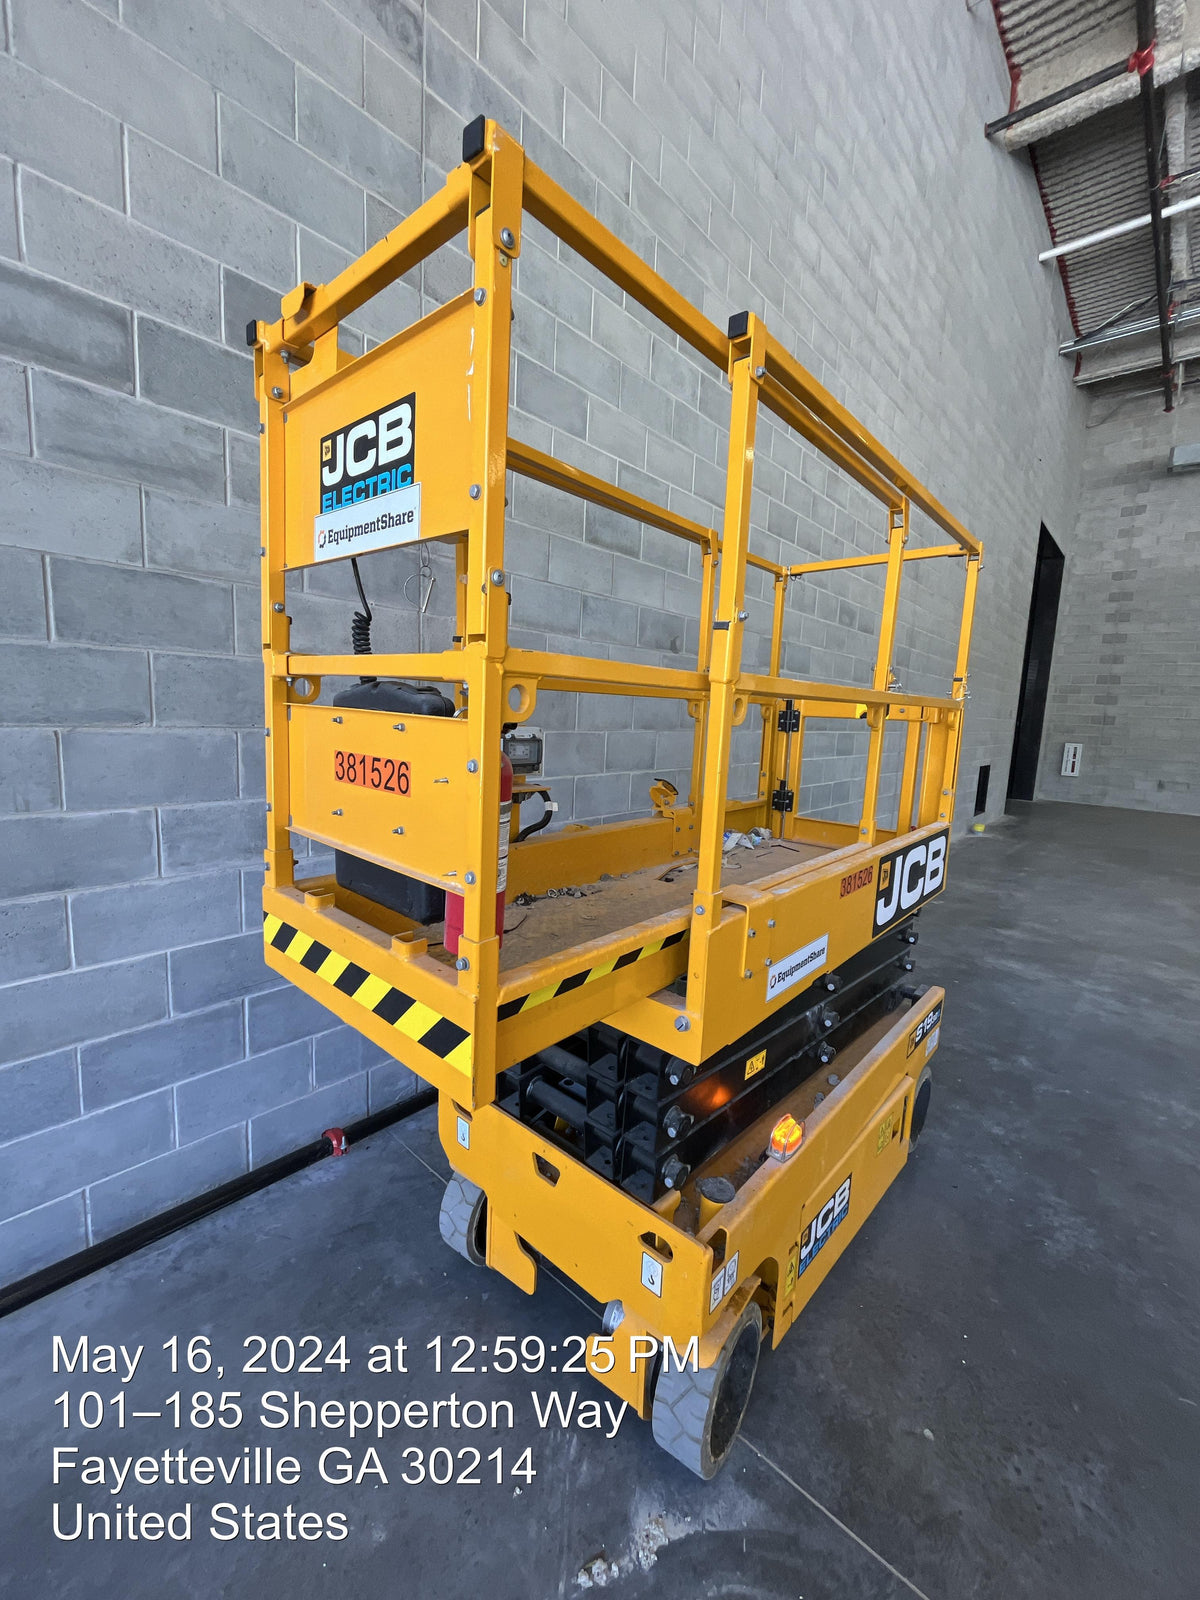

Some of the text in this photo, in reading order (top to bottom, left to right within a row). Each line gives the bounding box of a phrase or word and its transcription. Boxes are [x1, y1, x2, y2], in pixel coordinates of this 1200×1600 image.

[322, 403, 412, 487] JCB
[322, 463, 412, 514] ELECTRIC
[327, 509, 414, 545] EquipmentShare
[335, 751, 409, 794] 381526
[840, 865, 873, 897] 381526
[876, 835, 946, 926] JCB
[777, 947, 825, 983] EquipmentShare
[799, 1203, 849, 1276] ELECTRIC
[800, 1178, 850, 1260] JCB
